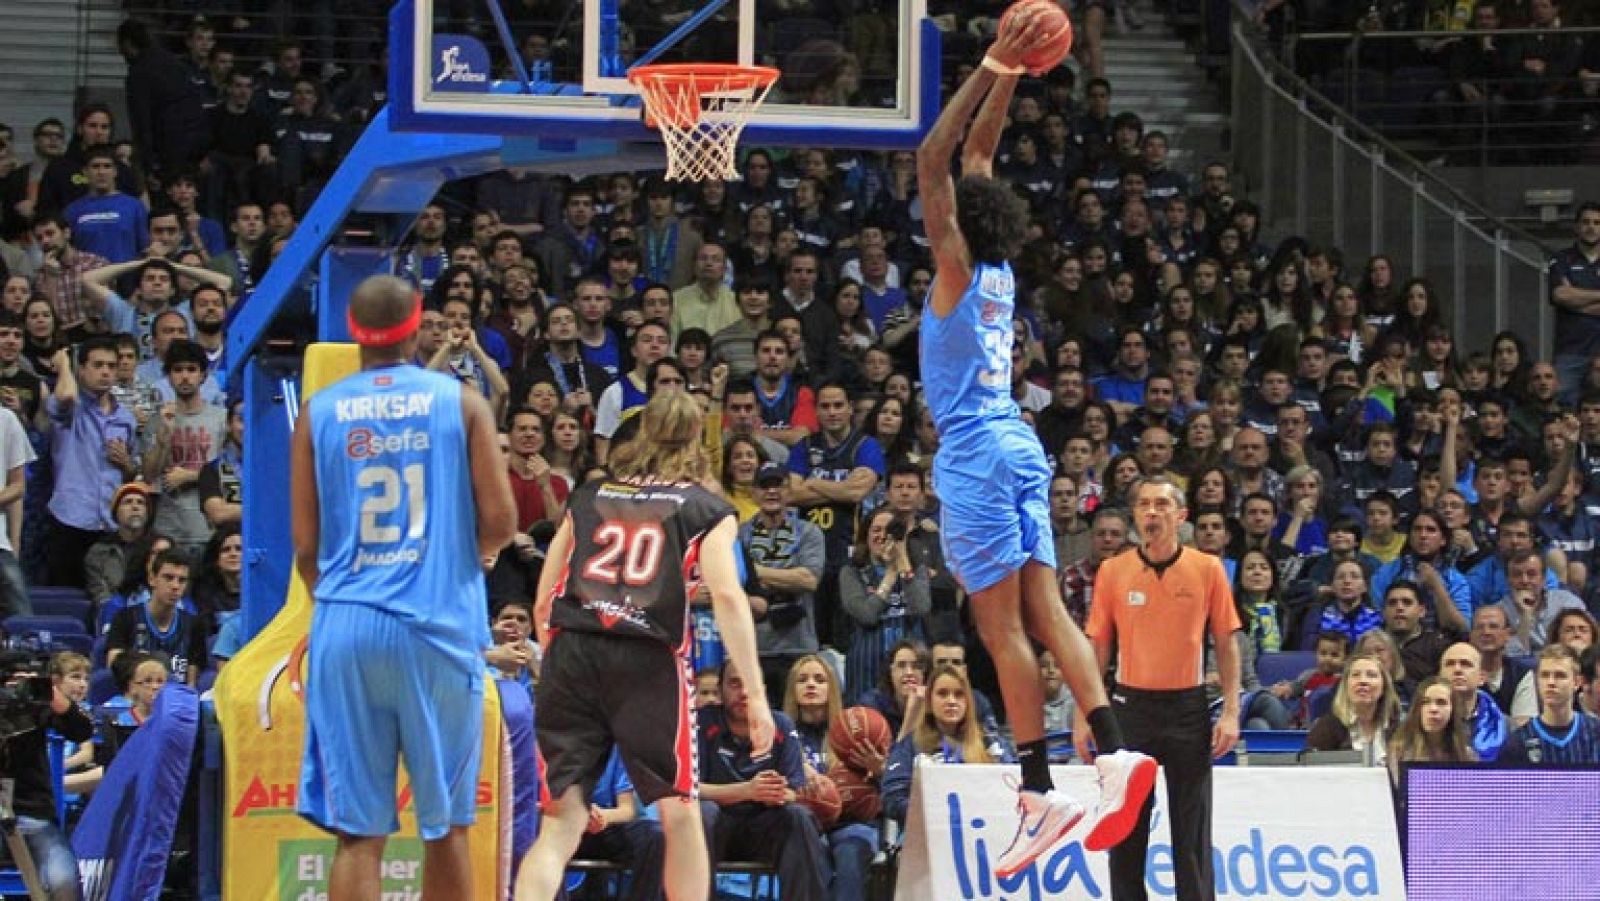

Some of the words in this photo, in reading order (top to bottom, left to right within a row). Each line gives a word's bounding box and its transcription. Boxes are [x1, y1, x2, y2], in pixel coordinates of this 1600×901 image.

[336, 392, 433, 423] KIRKSAY
[347, 427, 430, 459] asefa
[357, 464, 427, 545] 21
[583, 520, 665, 587] 20
[297, 853, 324, 881] El
